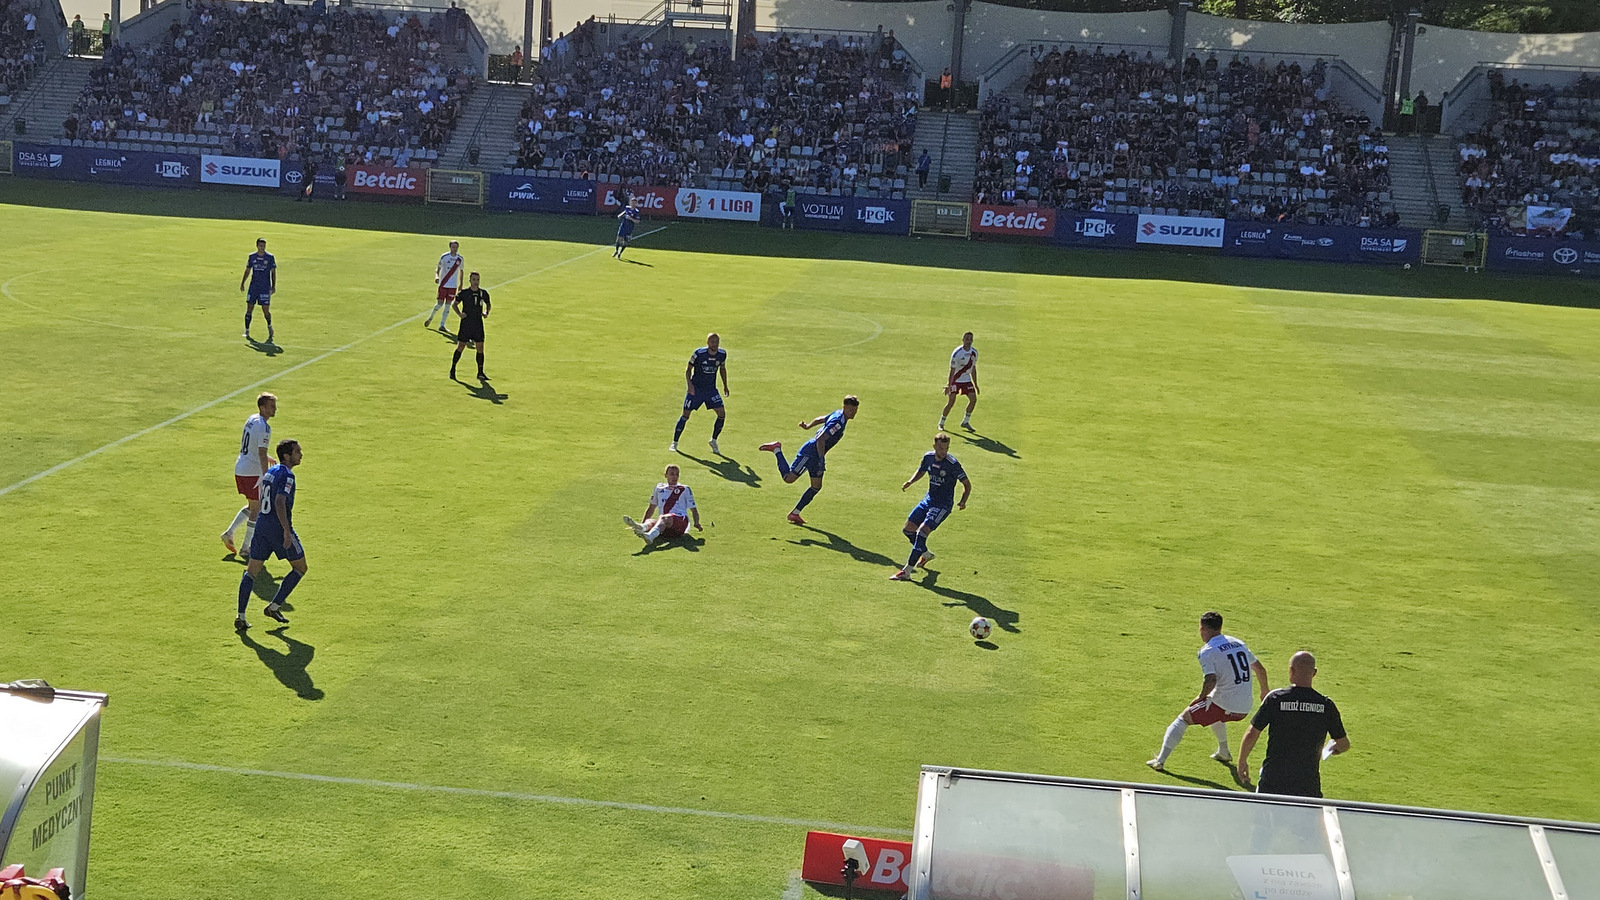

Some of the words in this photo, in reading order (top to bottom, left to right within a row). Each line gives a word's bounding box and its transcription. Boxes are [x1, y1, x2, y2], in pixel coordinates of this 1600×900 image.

[19, 152, 36, 161] DSA
[37, 153, 49, 162] SA
[95, 158, 121, 168] LEGNICA
[155, 162, 190, 176] LPGK
[221, 165, 277, 178] SUZUKI
[354, 170, 417, 190] Betclic
[604, 189, 664, 209] Bclic
[708, 197, 715, 211] 1
[721, 198, 753, 213] LIGA
[802, 203, 844, 216] VOTUM
[857, 208, 895, 222] LPGK
[980, 210, 1047, 230] Betclic
[1075, 221, 1116, 235] LPGK
[1159, 225, 1221, 238] SUZUKI
[1240, 231, 1266, 239] LEGNICA
[1361, 237, 1378, 246] DSA
[1380, 238, 1391, 247] SA
[1227, 651, 1250, 684] 19
[1299, 702, 1325, 713] LEGNICA
[46, 763, 77, 806] PUNKT
[32, 793, 84, 851] MEDYCZNY
[1261, 867, 1316, 880] LEGNICA
